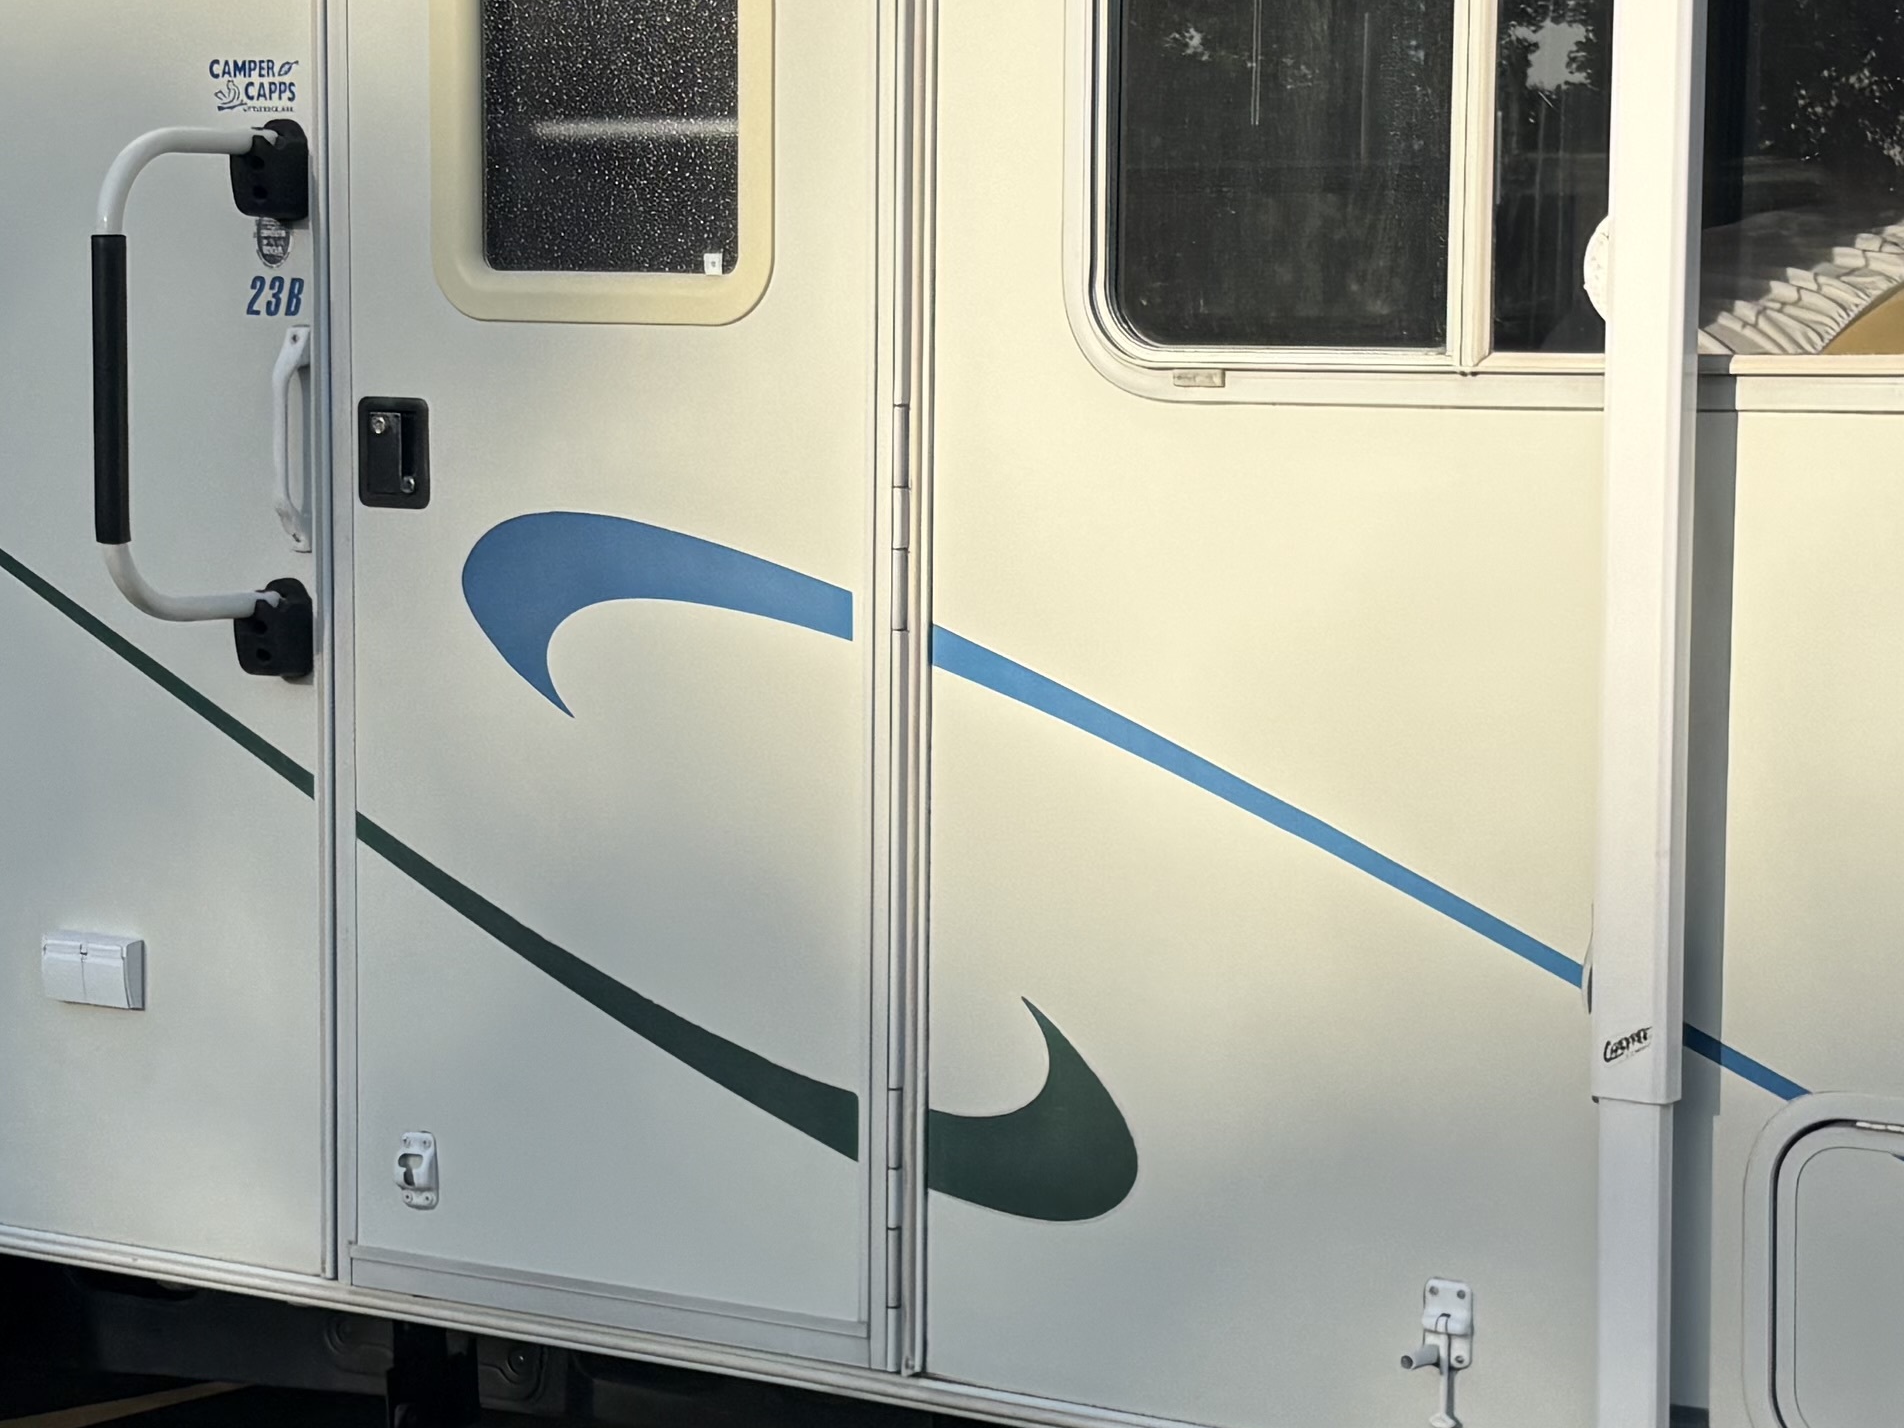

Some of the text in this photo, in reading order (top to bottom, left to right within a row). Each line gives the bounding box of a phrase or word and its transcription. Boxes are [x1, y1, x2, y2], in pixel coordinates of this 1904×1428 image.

[208, 58, 275, 79] CAMPER
[244, 81, 296, 102] CAPPS
[246, 275, 305, 317] 23B
